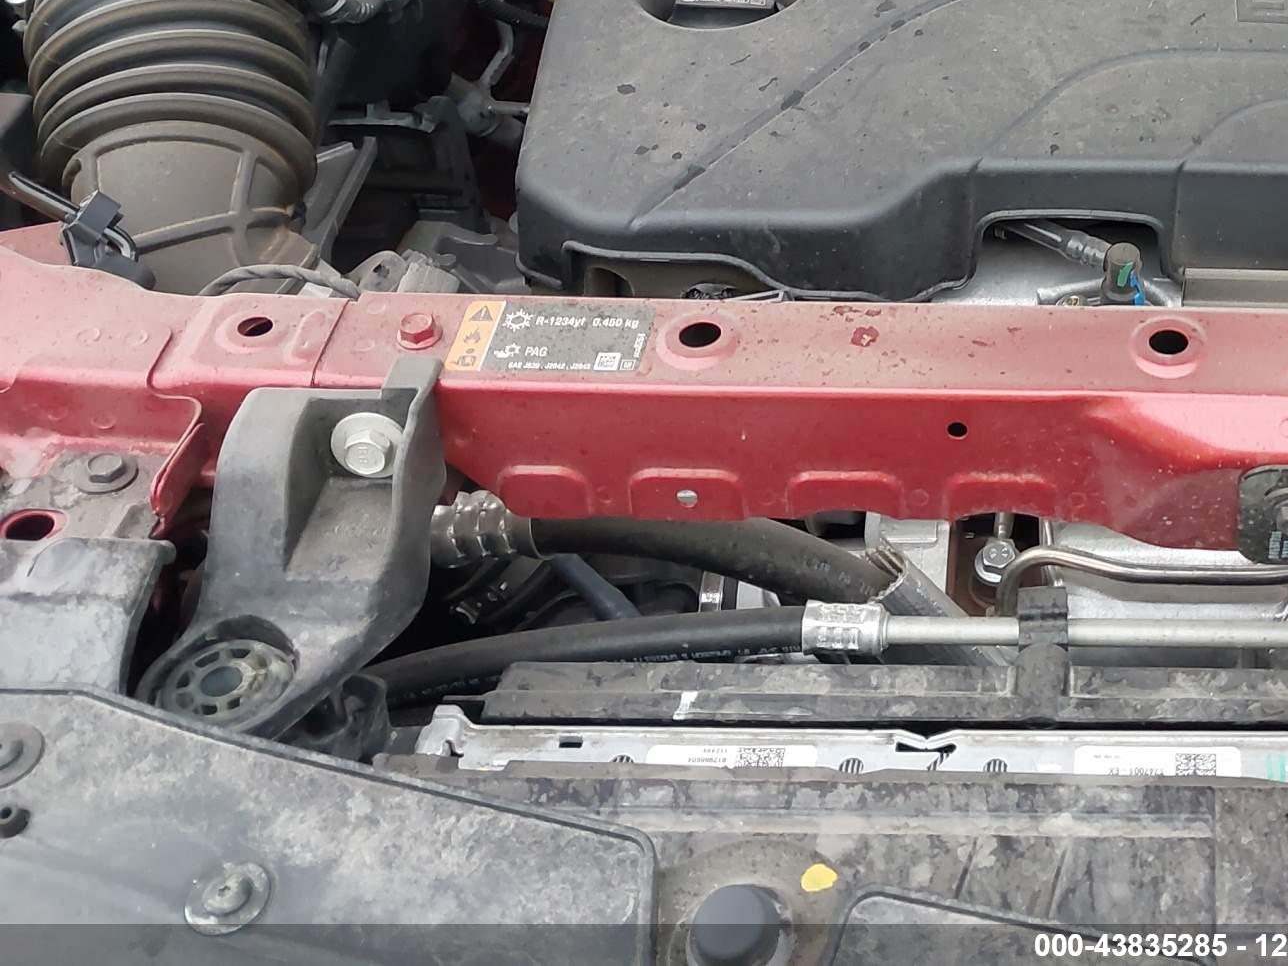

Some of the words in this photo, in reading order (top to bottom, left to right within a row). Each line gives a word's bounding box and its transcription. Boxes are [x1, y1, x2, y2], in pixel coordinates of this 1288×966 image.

[535, 316, 586, 330] R-1234yf
[624, 317, 639, 329] kg
[524, 346, 549, 357] PAG
